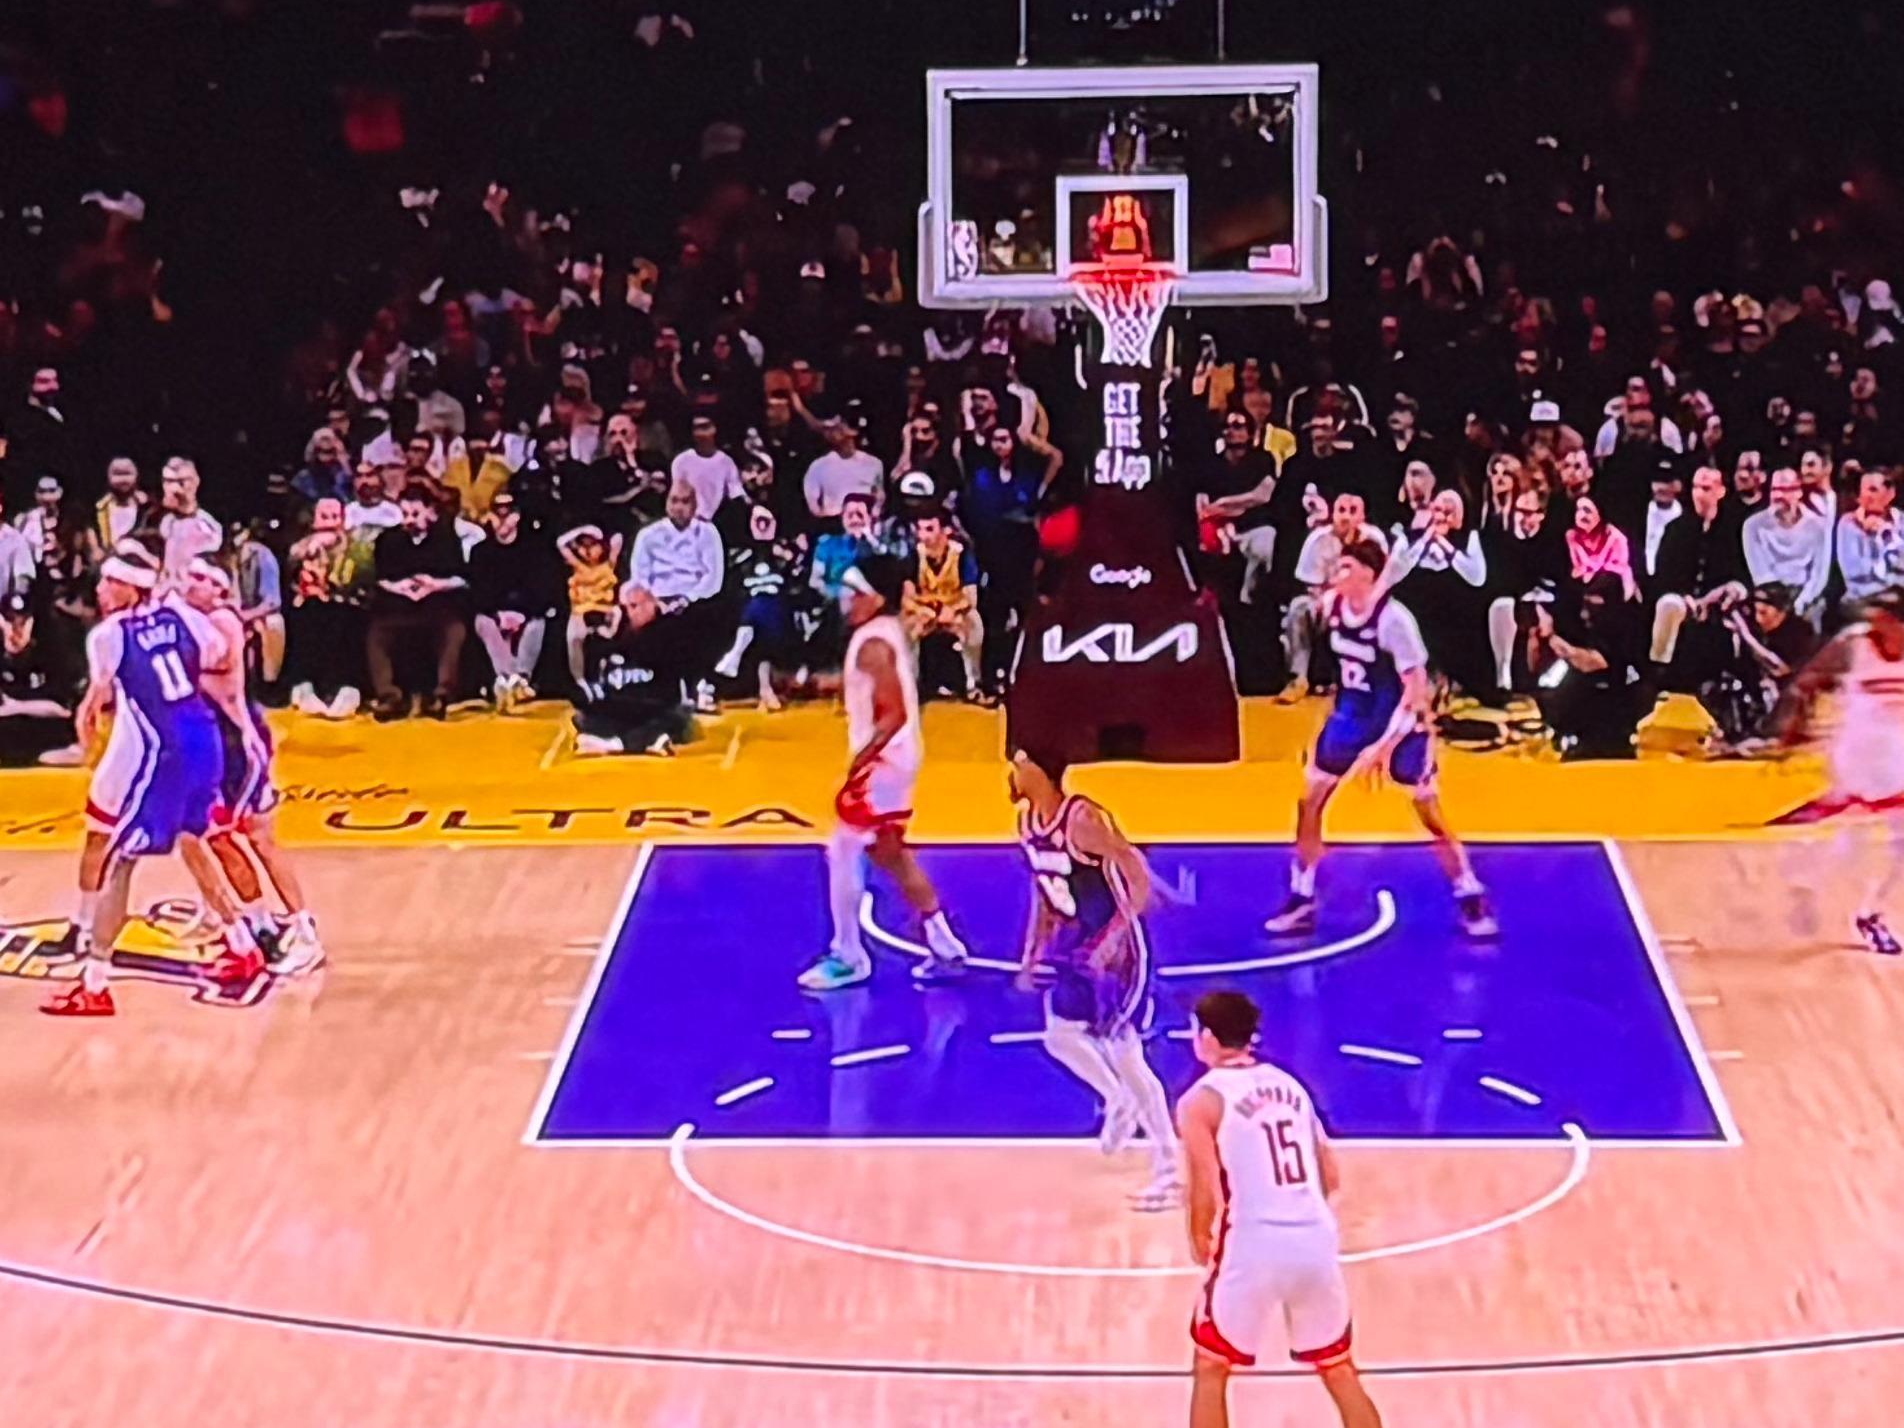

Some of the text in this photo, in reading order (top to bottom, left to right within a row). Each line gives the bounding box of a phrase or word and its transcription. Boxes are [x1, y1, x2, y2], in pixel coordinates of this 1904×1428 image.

[151, 652, 192, 702] 11
[323, 808, 816, 831] ULTRA
[1260, 1119, 1307, 1187] 15
